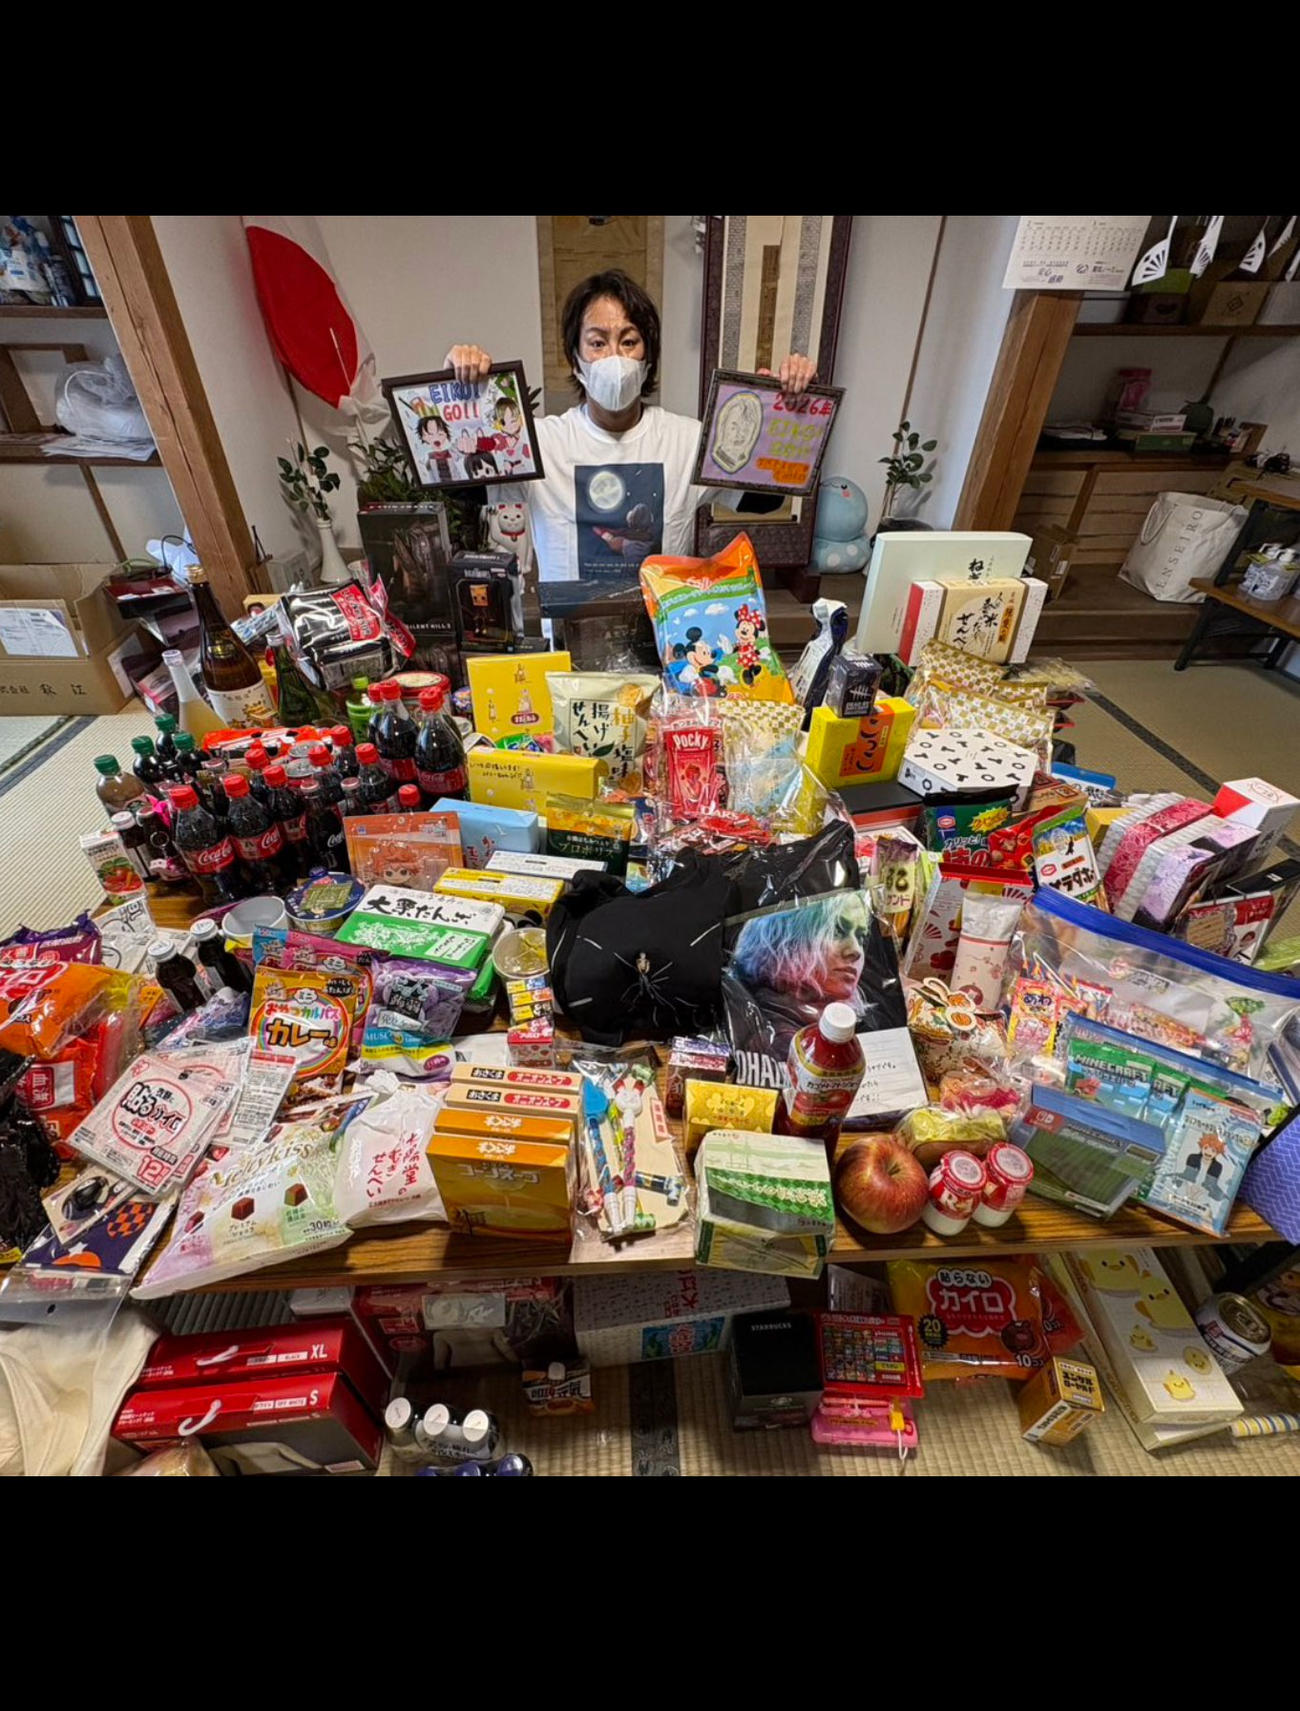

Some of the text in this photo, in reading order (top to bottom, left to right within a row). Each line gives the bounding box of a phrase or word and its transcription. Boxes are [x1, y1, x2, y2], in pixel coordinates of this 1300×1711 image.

[592, 702, 610, 742] 揚げ
[264, 1001, 340, 1020] おやつカルパス
[457, 1162, 540, 1184] コーンスープ
[940, 1271, 991, 1287] 貼らない
[939, 1288, 1005, 1314] カイロ
[751, 1322, 792, 1332] STARBUCKS
[923, 1319, 941, 1332] 20
[310, 1344, 328, 1360] XL
[309, 1389, 319, 1405] S
